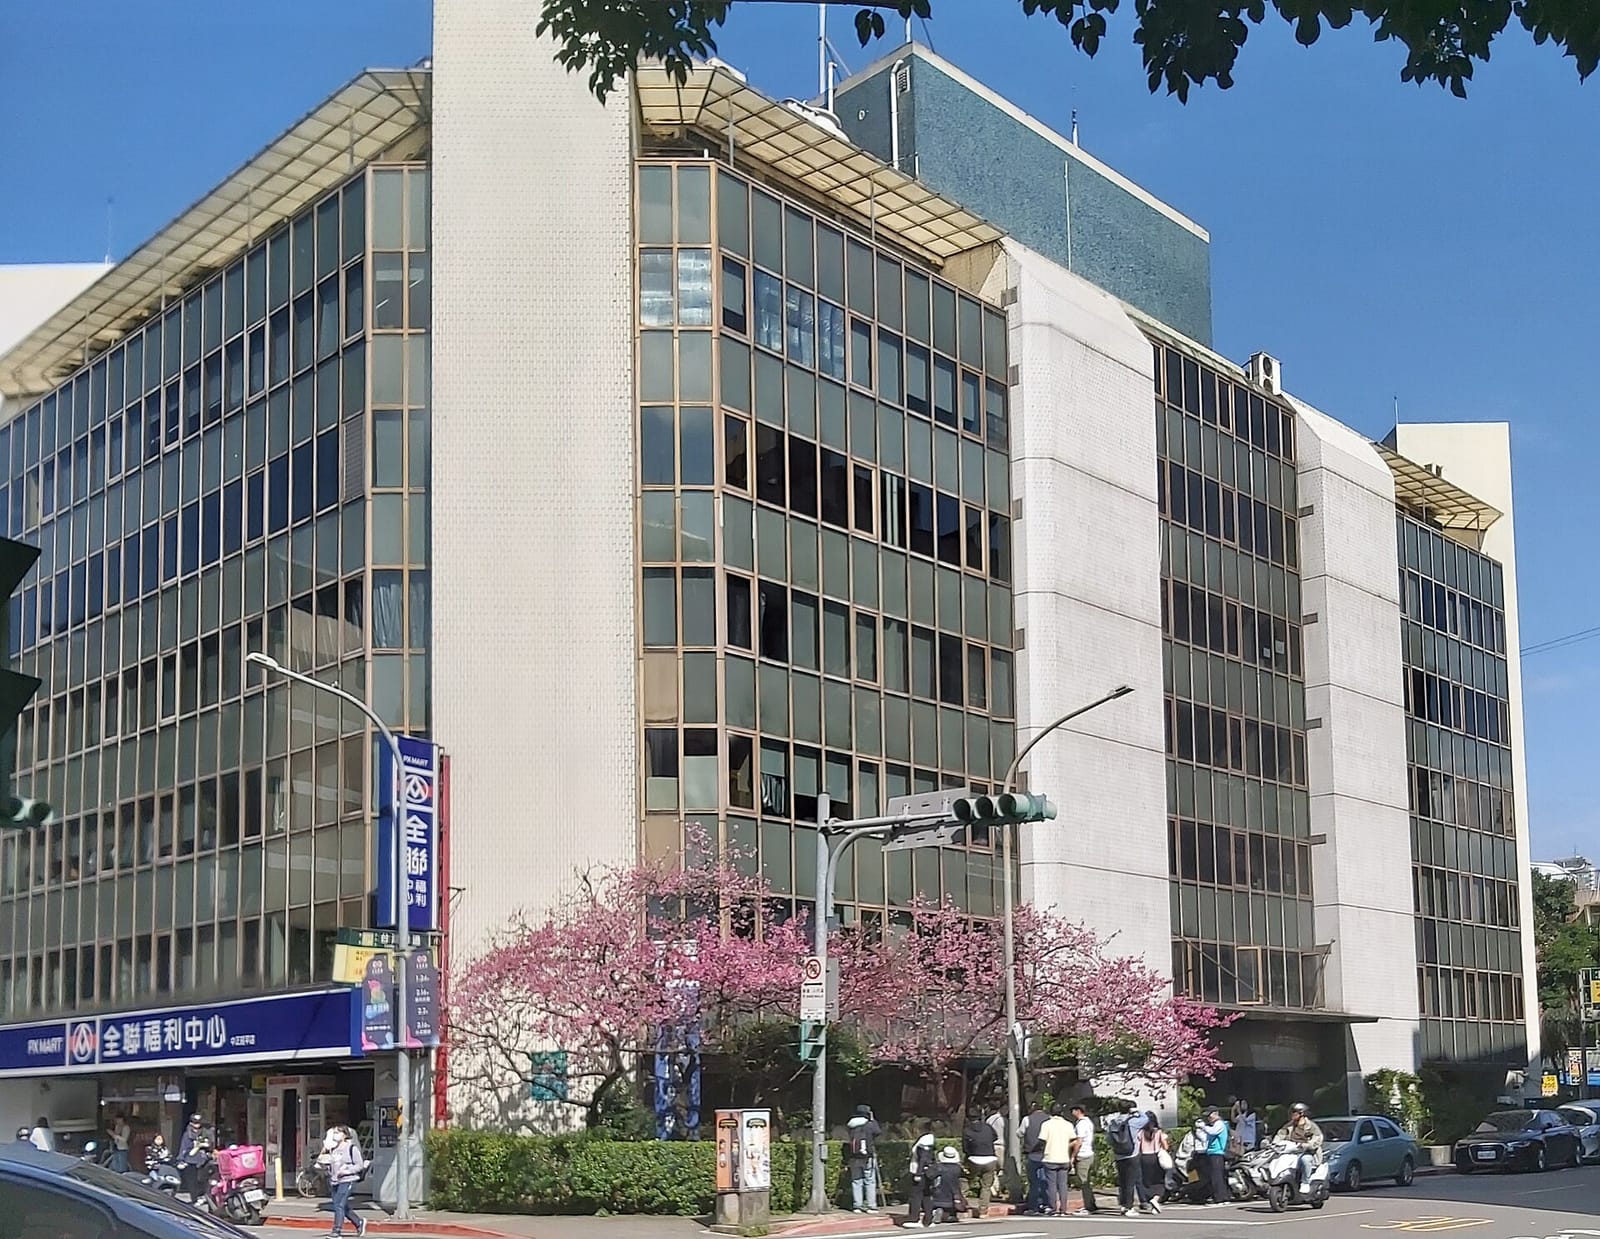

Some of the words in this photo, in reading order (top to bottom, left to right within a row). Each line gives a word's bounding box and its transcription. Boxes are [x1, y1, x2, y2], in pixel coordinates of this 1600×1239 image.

[39, 1037, 64, 1054] MART
[103, 1014, 227, 1058] 全聯福利中心
